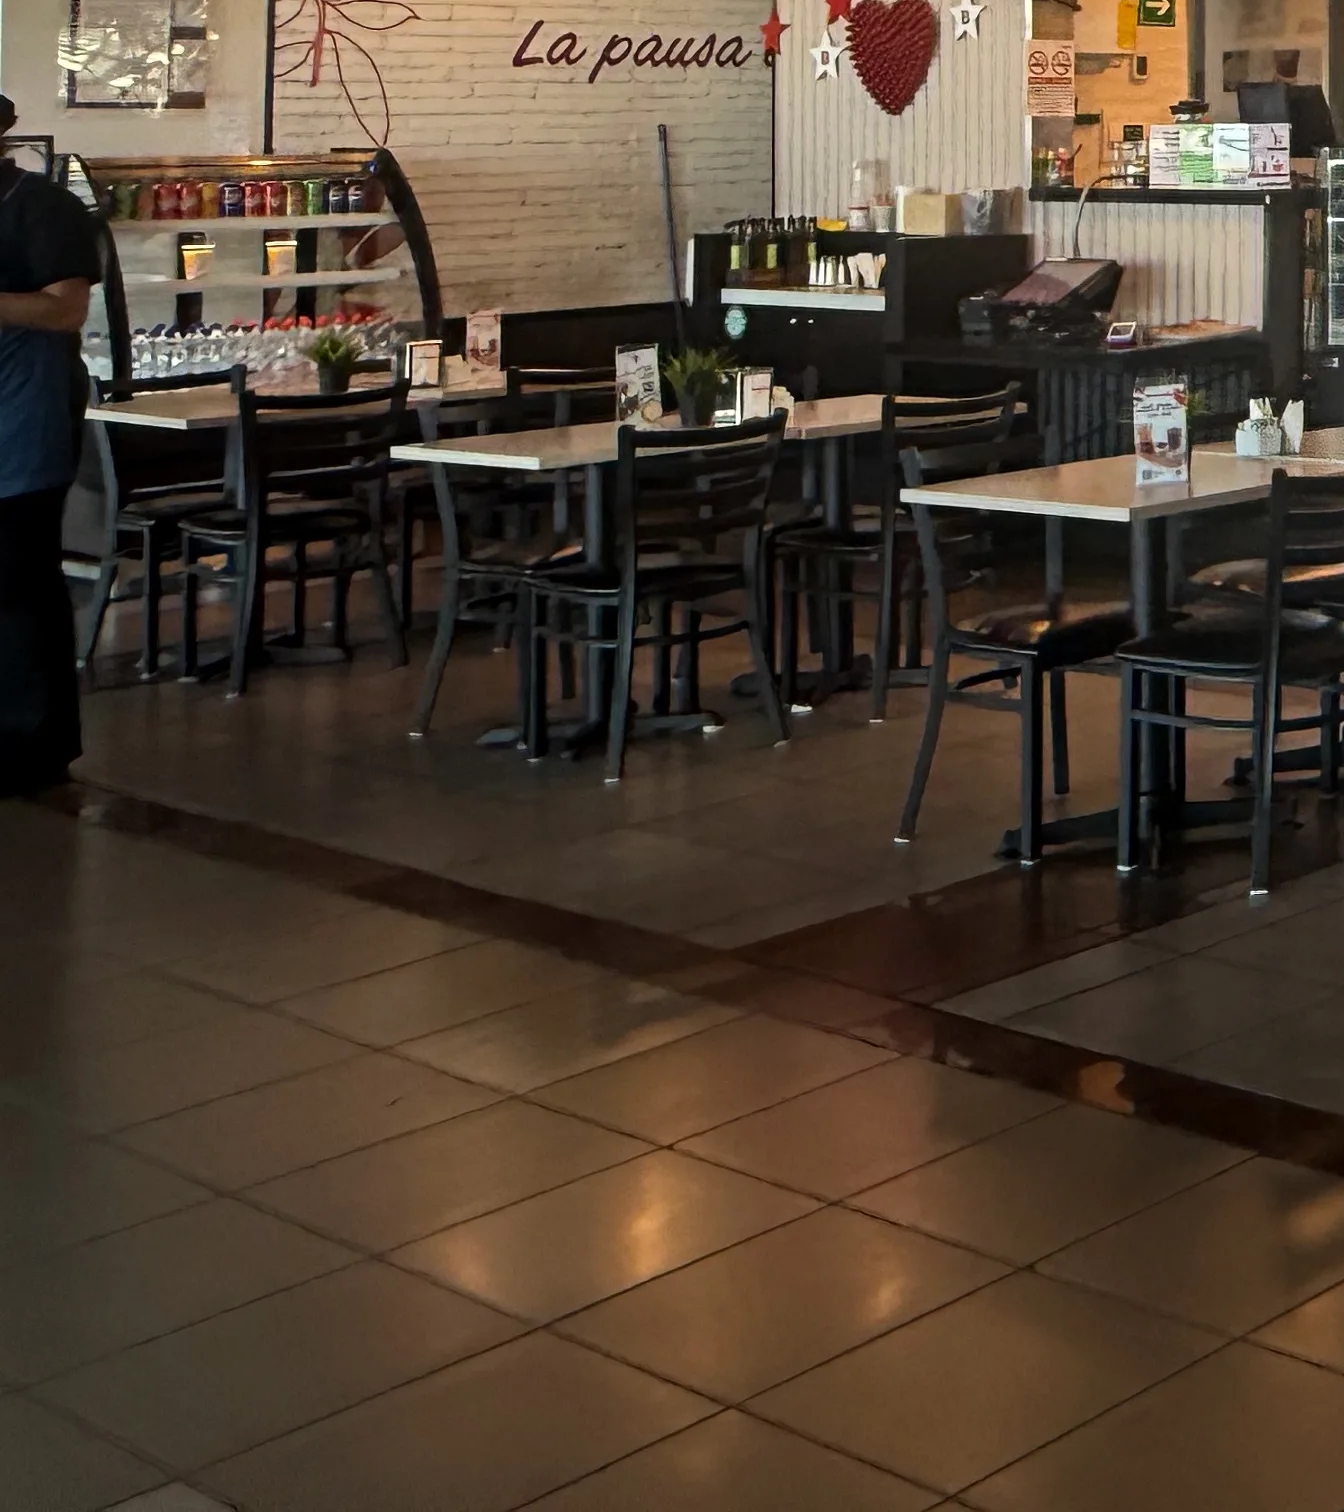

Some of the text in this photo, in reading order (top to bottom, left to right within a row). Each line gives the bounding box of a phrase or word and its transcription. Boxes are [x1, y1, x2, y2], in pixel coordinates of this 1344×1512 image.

[960, 10, 970, 24] B
[512, 19, 752, 84] La pausa
